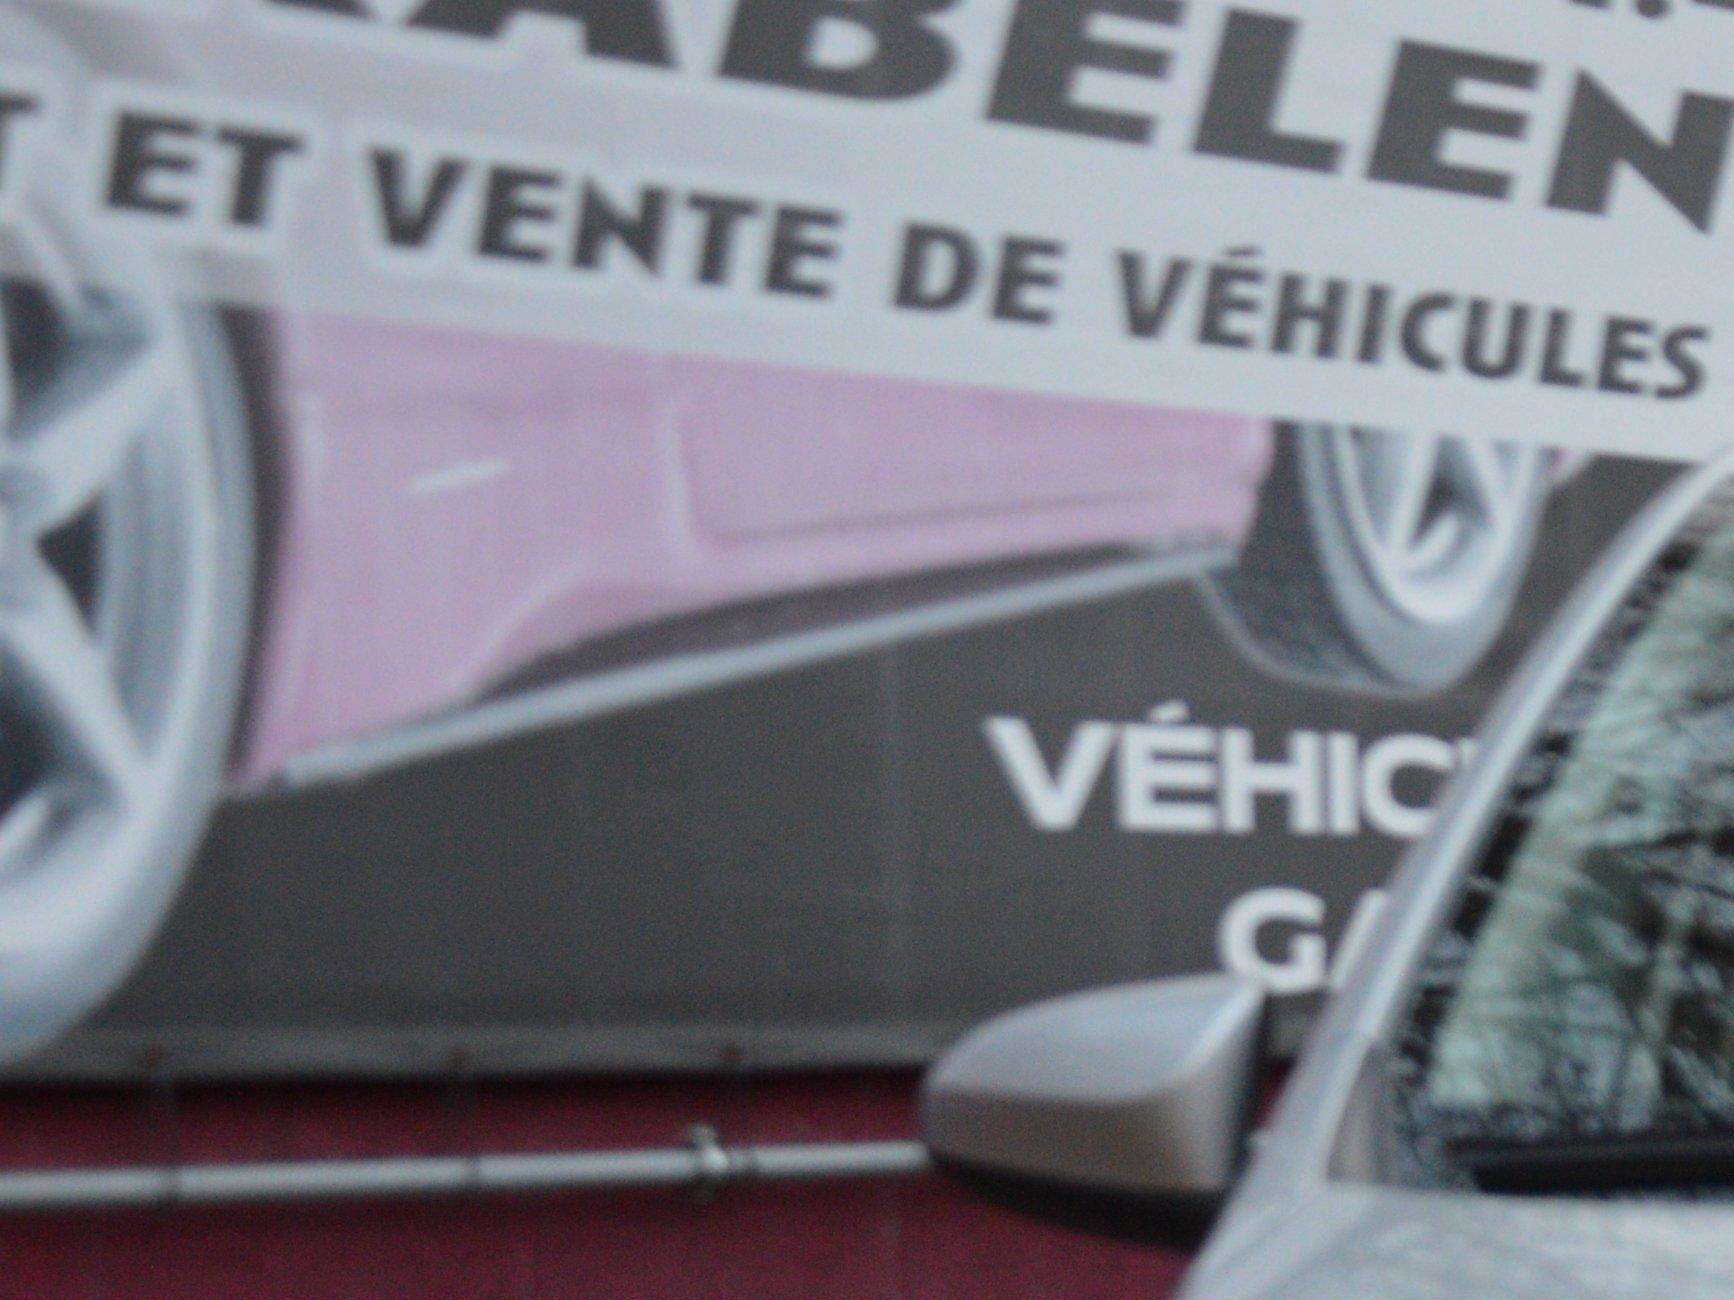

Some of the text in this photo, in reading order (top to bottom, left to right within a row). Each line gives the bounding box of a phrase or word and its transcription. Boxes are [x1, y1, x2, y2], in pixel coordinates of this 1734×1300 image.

[104, 108, 306, 229] ET
[364, 143, 846, 302] VENTE
[890, 220, 1066, 328] DE
[1114, 245, 1711, 402] VÉHICULES
[985, 699, 1480, 838] VÉHIC
